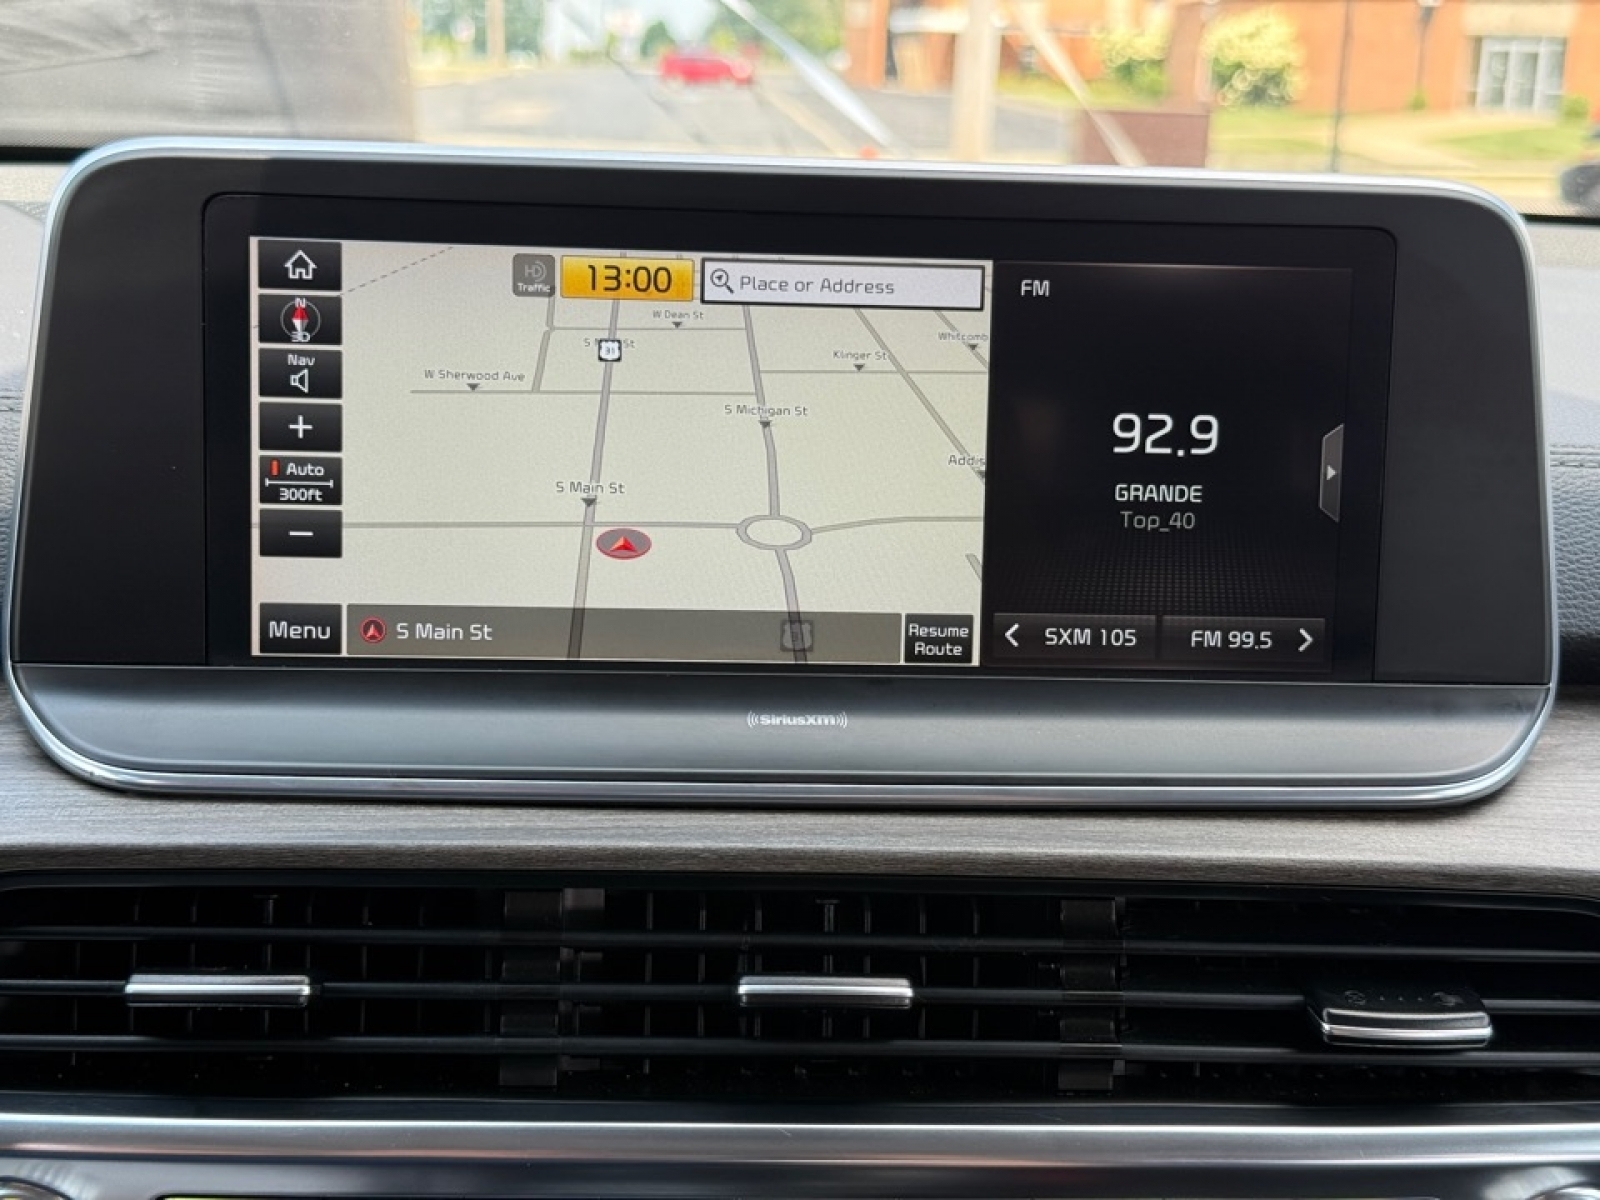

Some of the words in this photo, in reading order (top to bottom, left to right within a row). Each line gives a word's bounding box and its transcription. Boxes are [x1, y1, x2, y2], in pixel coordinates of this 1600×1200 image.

[587, 264, 673, 293] 13:00
[739, 275, 789, 292] Place
[795, 278, 814, 293] or
[819, 278, 895, 295] Address
[517, 283, 551, 293] Traffic
[1020, 279, 1051, 298] FM
[294, 297, 307, 308] N
[652, 310, 662, 319] W
[663, 310, 691, 320] Dean
[693, 311, 704, 320] St
[291, 331, 311, 343] 3D
[583, 337, 591, 348] S
[287, 353, 316, 366] Nav
[832, 350, 872, 362] Klinger
[873, 351, 887, 361] St
[424, 369, 435, 380] W
[438, 369, 500, 382] Sherwood
[502, 371, 526, 382] Ave
[724, 404, 732, 416] S
[736, 404, 790, 418] Michigan
[794, 406, 809, 417] St
[1111, 412, 1220, 457] 92.9
[286, 463, 325, 477] Auto
[279, 488, 323, 502] 300ft
[556, 481, 564, 493] S
[569, 481, 604, 495] Main
[609, 482, 625, 495] St
[1114, 483, 1203, 503] GRANDE
[1120, 511, 1196, 532] Top_40
[268, 620, 332, 640] Menu
[396, 623, 410, 640] S
[415, 623, 464, 641] Main
[469, 623, 493, 641] St
[908, 624, 970, 639] Resume
[1044, 627, 1092, 647] SXM
[1099, 628, 1137, 647] 105
[1190, 630, 1222, 649] FM
[1227, 630, 1273, 650] 99.5
[914, 642, 963, 657] Route
[758, 714, 837, 726] SiriusXM
